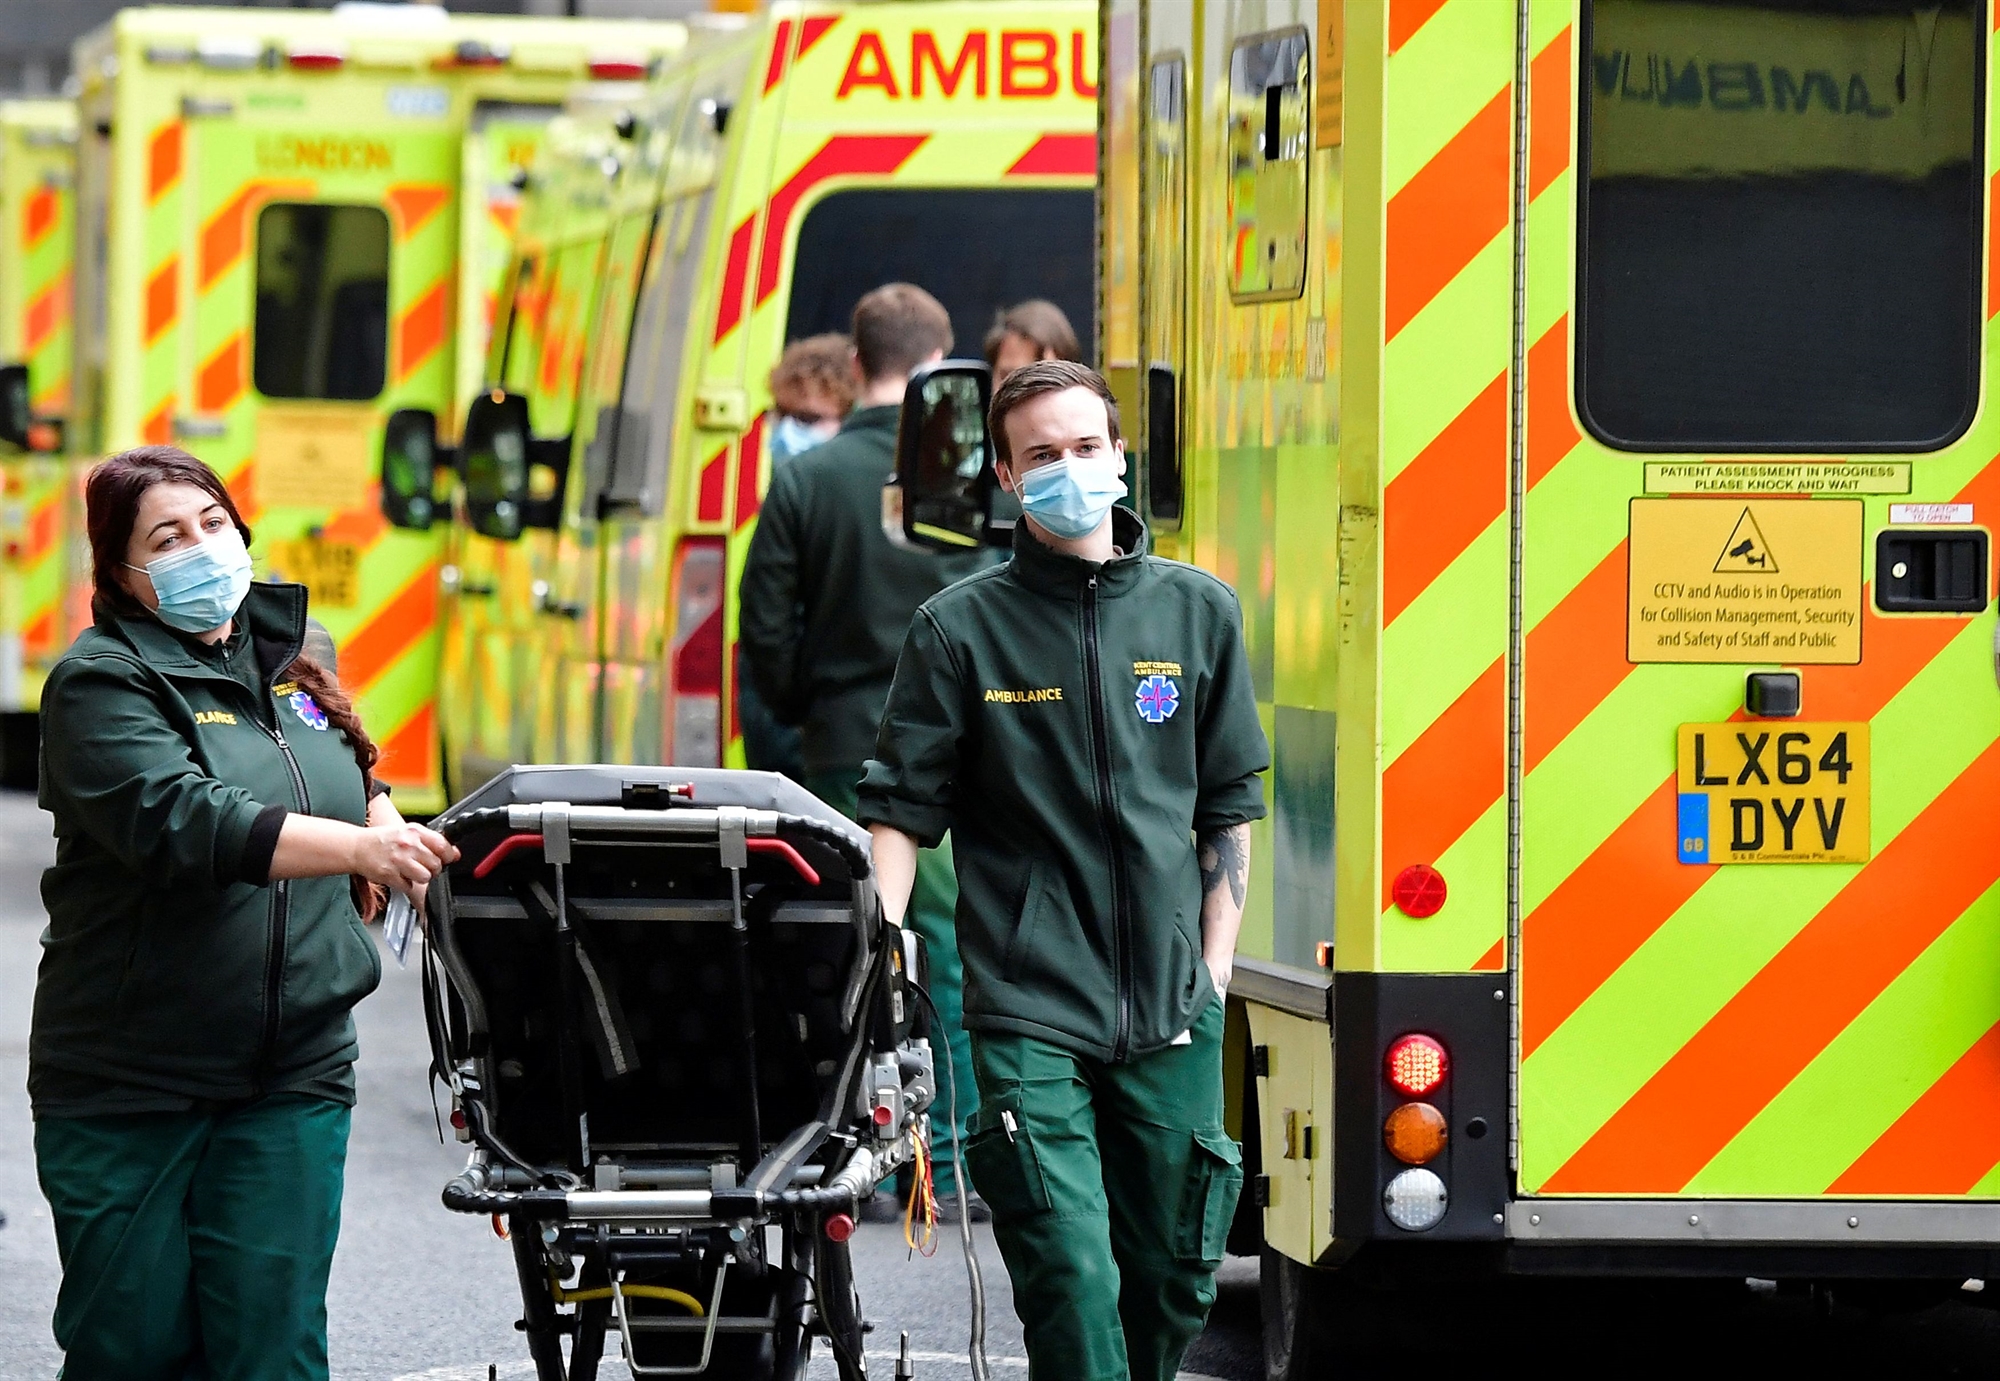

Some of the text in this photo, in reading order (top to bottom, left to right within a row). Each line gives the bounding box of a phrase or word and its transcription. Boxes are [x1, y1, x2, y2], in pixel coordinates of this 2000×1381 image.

[835, 30, 1099, 101] AMBU
[1660, 466, 1895, 477] PATIENT ASSESSMENT IN PROGRESS
[1694, 479, 1860, 490] PLEASE KNOCK AND WAIT
[1653, 582, 1842, 603] CCTV and Audio is in Operation
[1640, 606, 1855, 627] for Collision Management, Security
[1656, 630, 1837, 650] and Safety of Staff and Public
[984, 688, 1064, 704] AMBULANCE
[1694, 731, 1853, 786] LX64
[1729, 797, 1846, 851] DYV
[1683, 837, 1704, 853] GB
